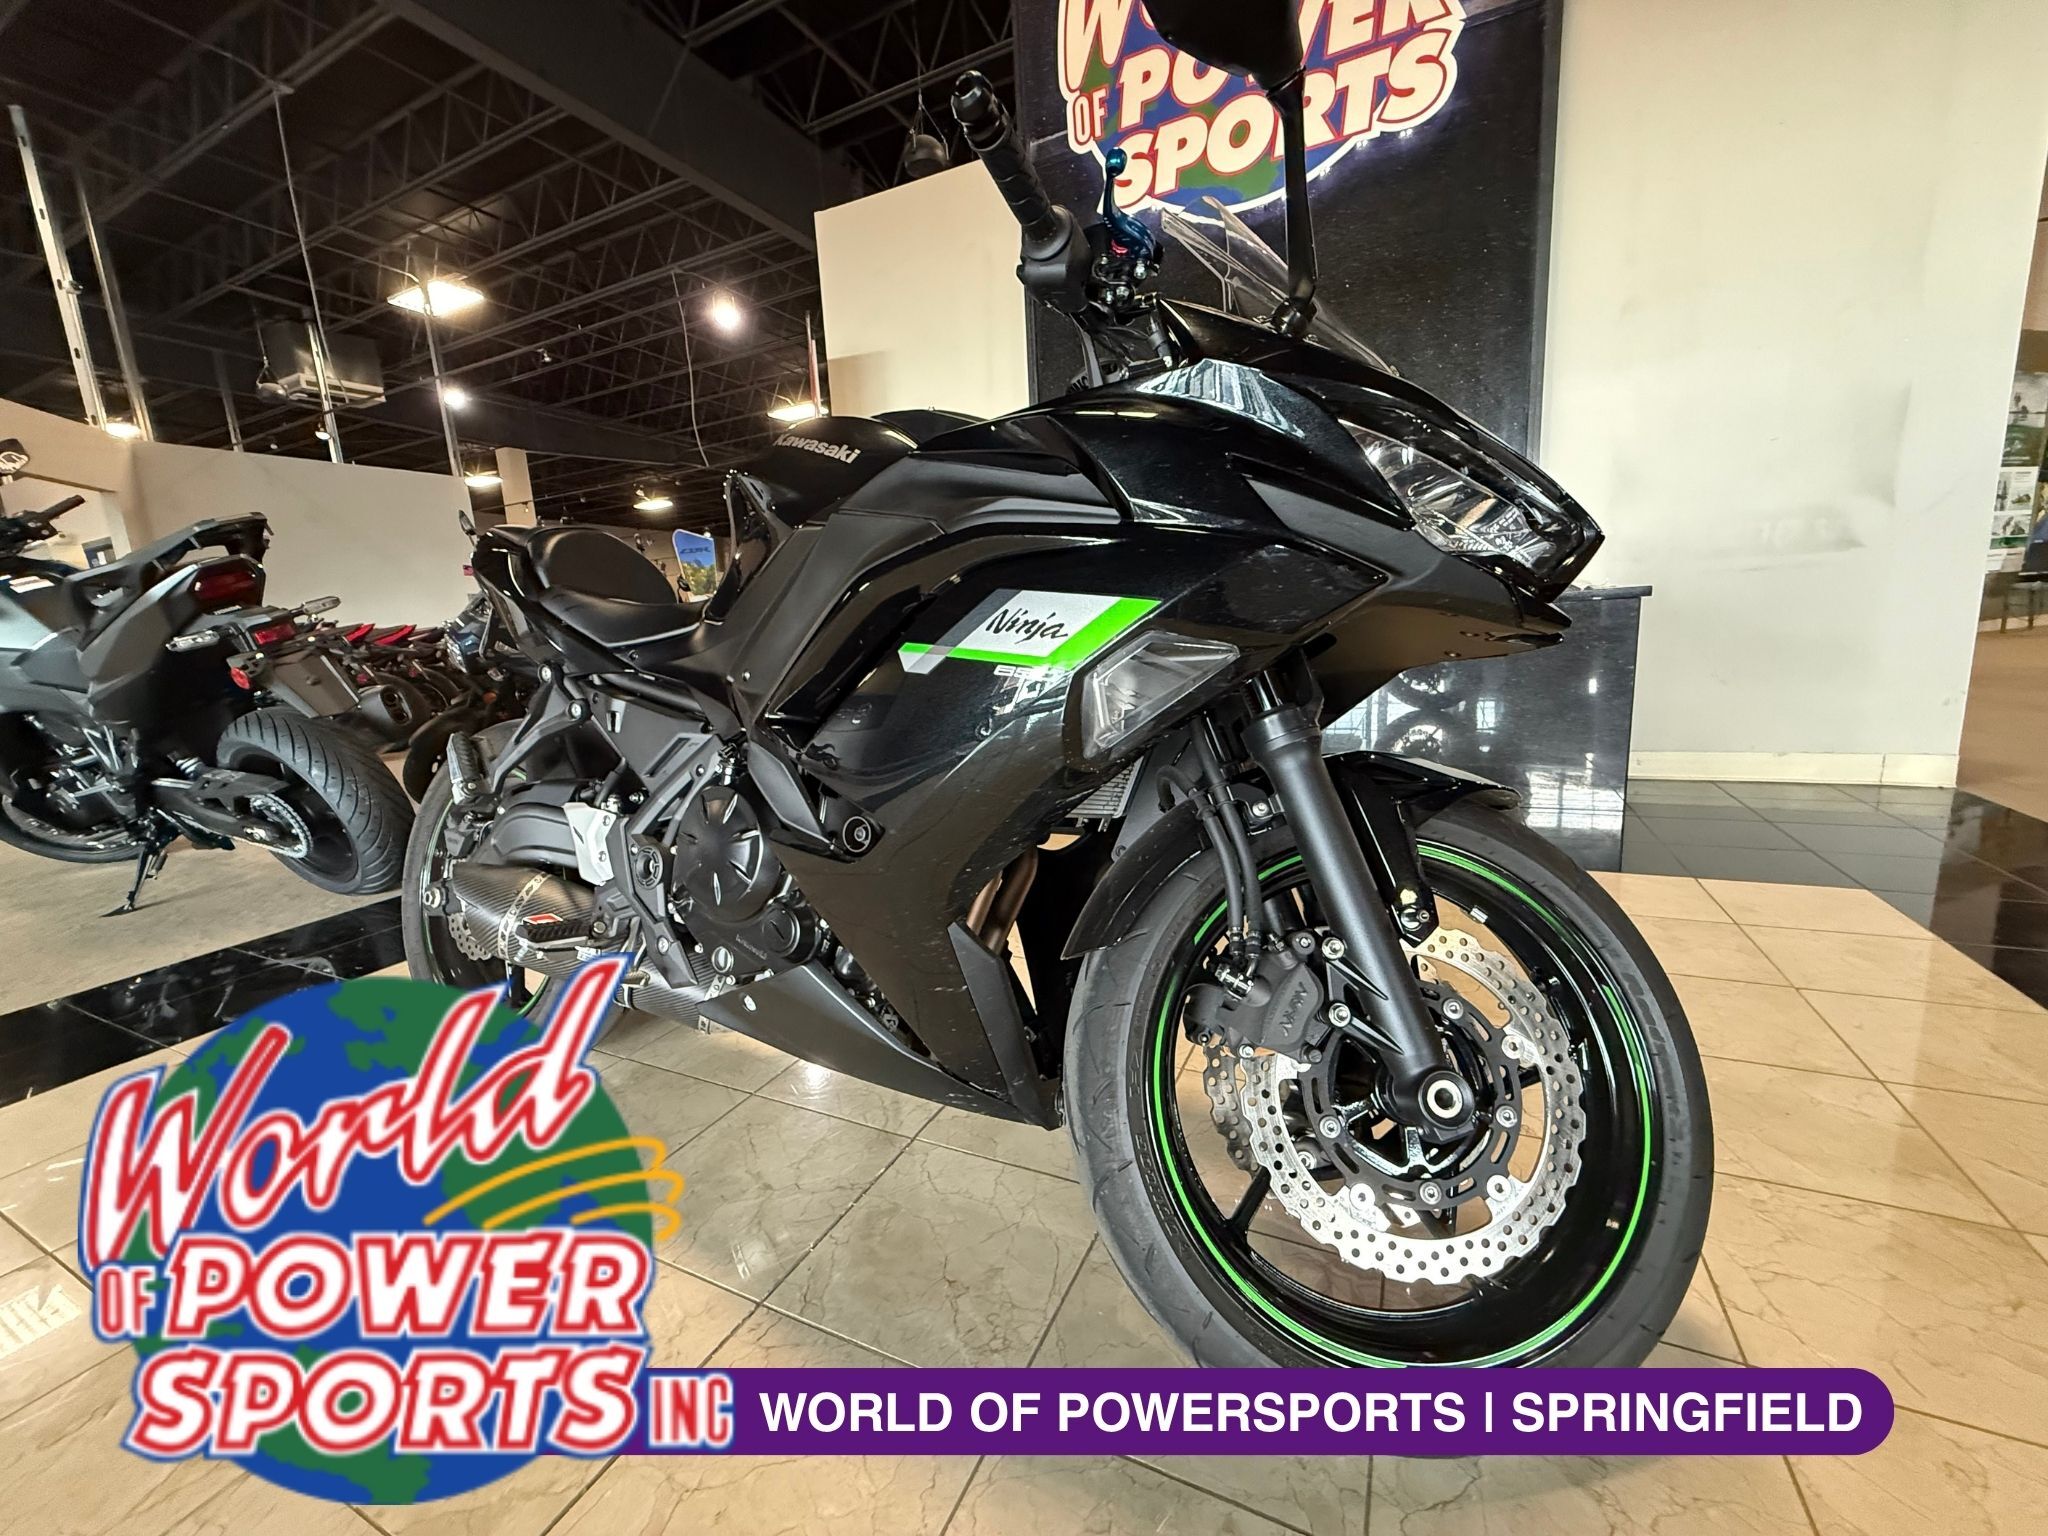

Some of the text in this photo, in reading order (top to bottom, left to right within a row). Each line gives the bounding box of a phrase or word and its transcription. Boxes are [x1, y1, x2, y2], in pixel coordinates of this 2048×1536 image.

[1072, 84, 1110, 147] OF
[773, 433, 861, 464] Kawasaki
[985, 607, 1068, 645] Ninja
